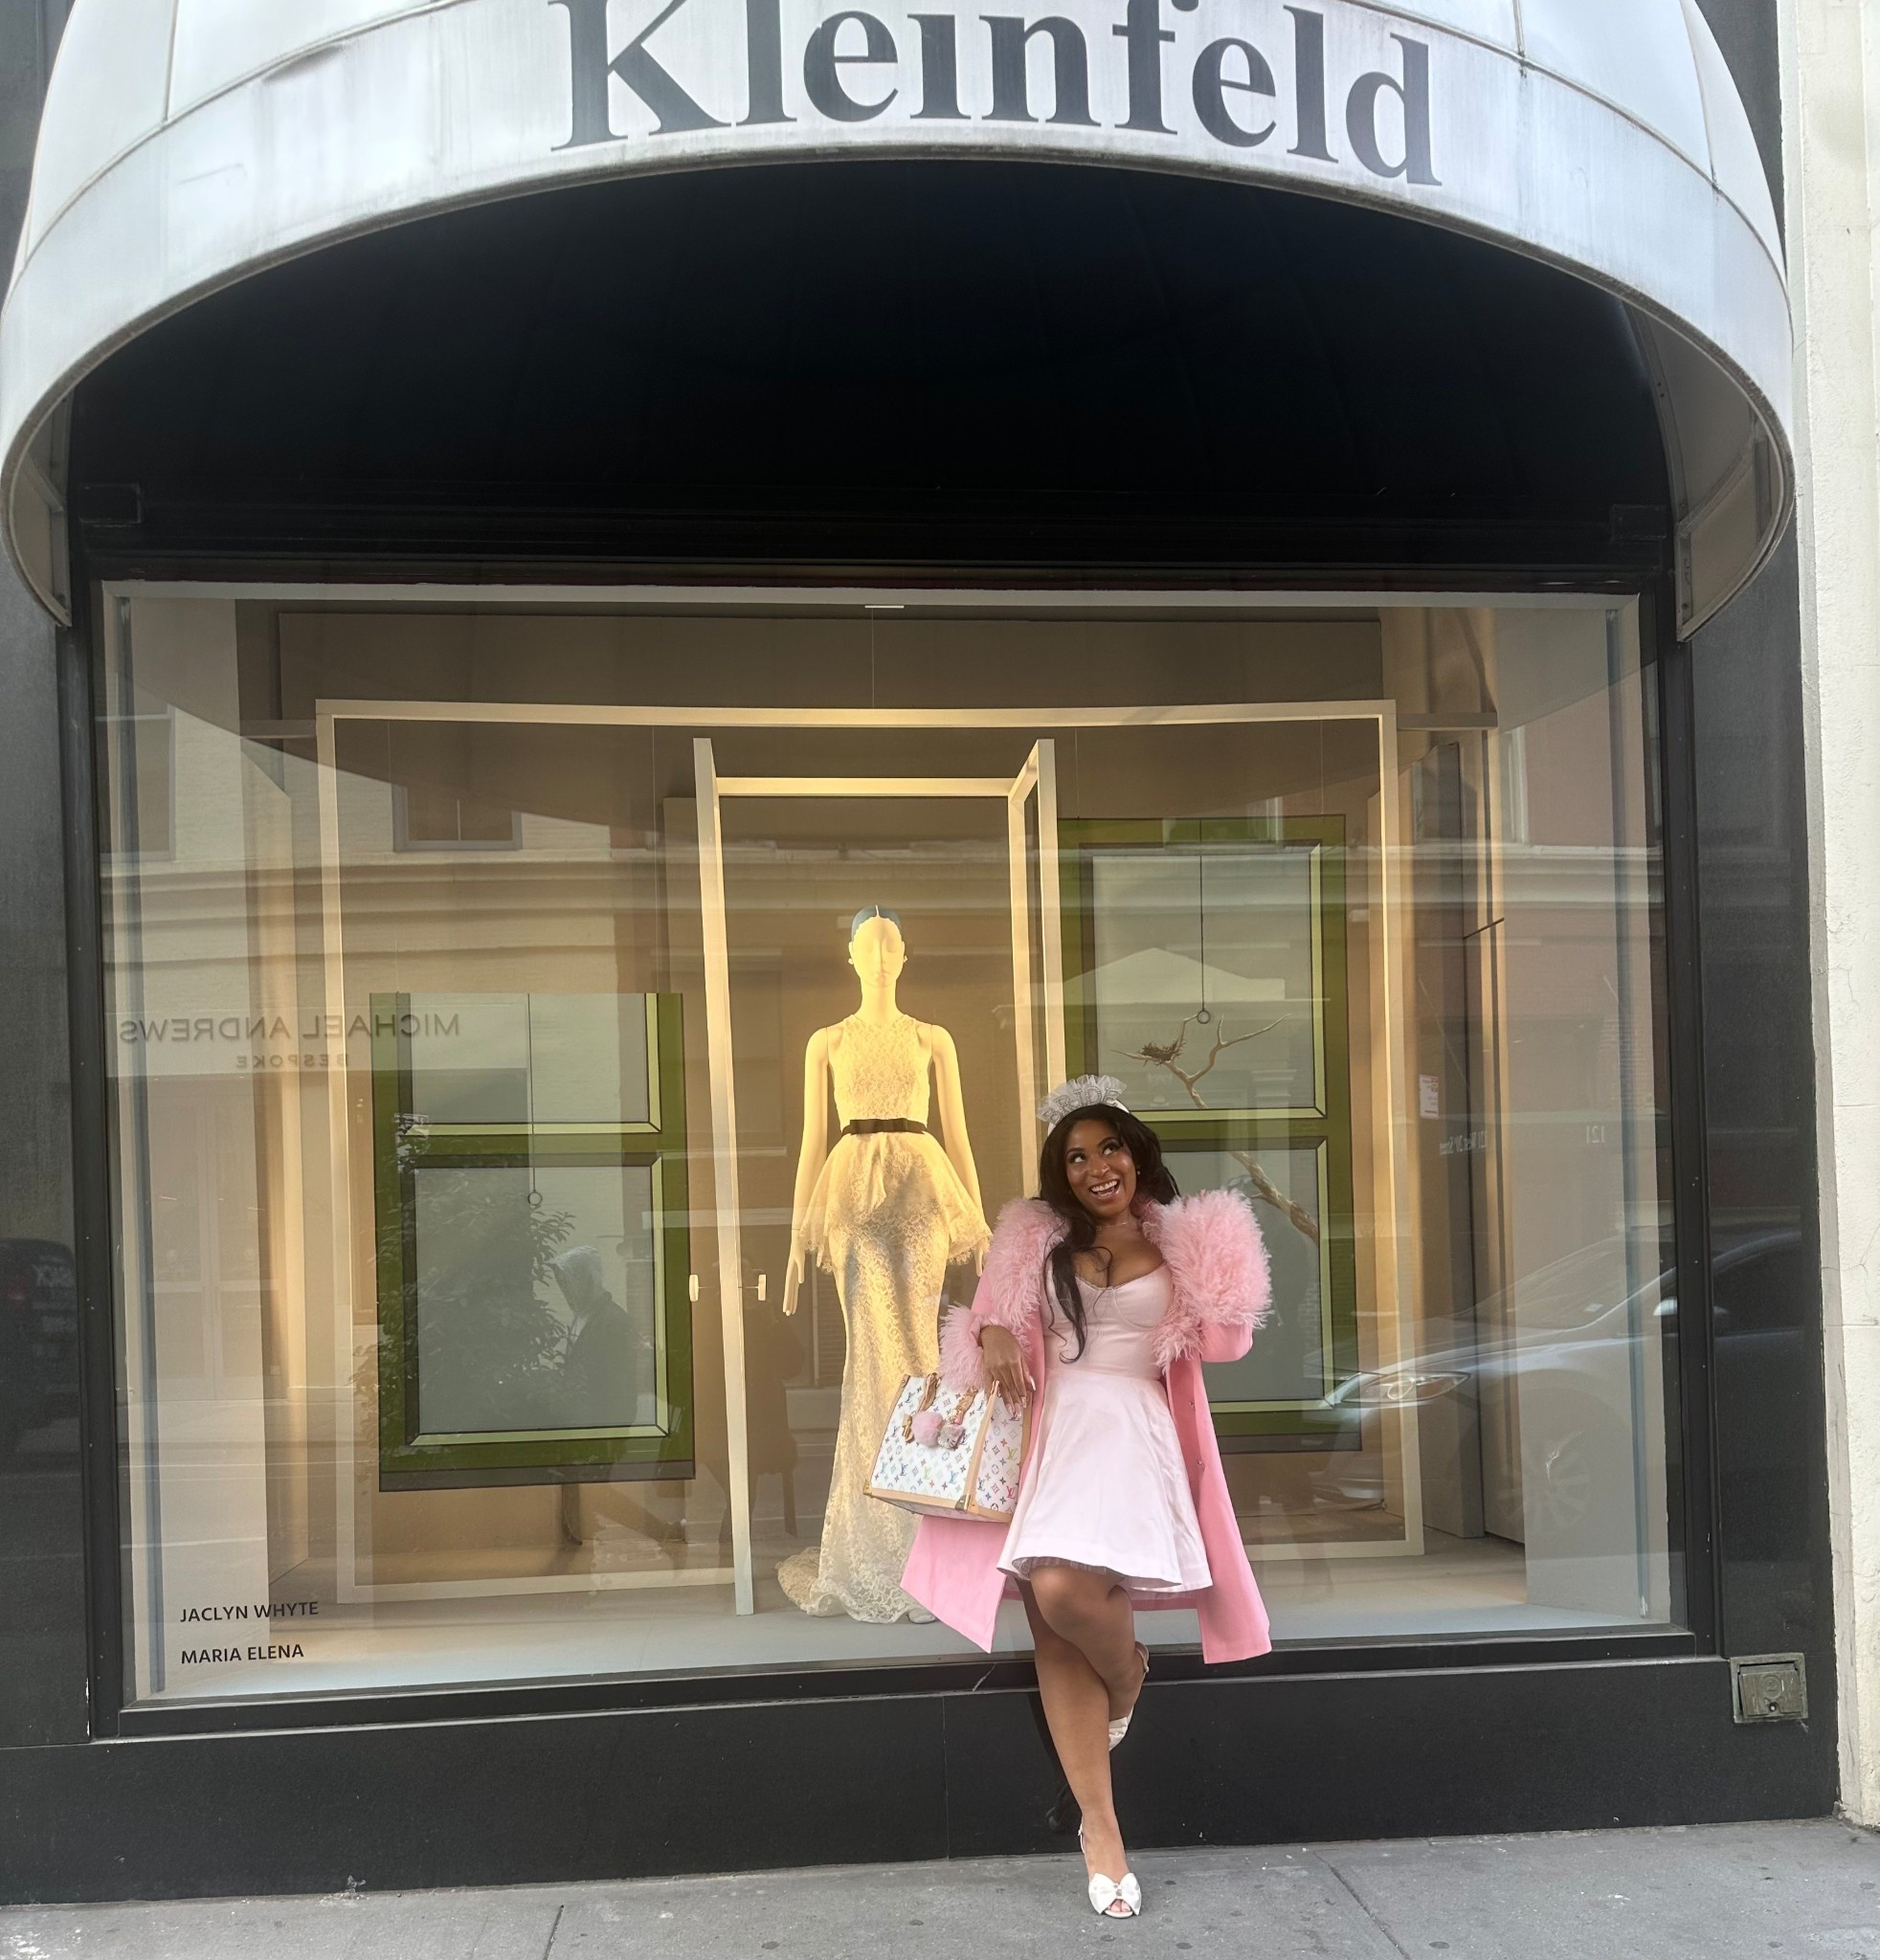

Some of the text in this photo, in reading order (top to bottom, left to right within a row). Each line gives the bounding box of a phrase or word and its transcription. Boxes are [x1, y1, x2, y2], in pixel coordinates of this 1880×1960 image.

[548, 0, 1443, 187] Kleinfeld
[180, 1601, 319, 1622] JACLYN WHYTE
[181, 1643, 304, 1664] MARIA ELENA
